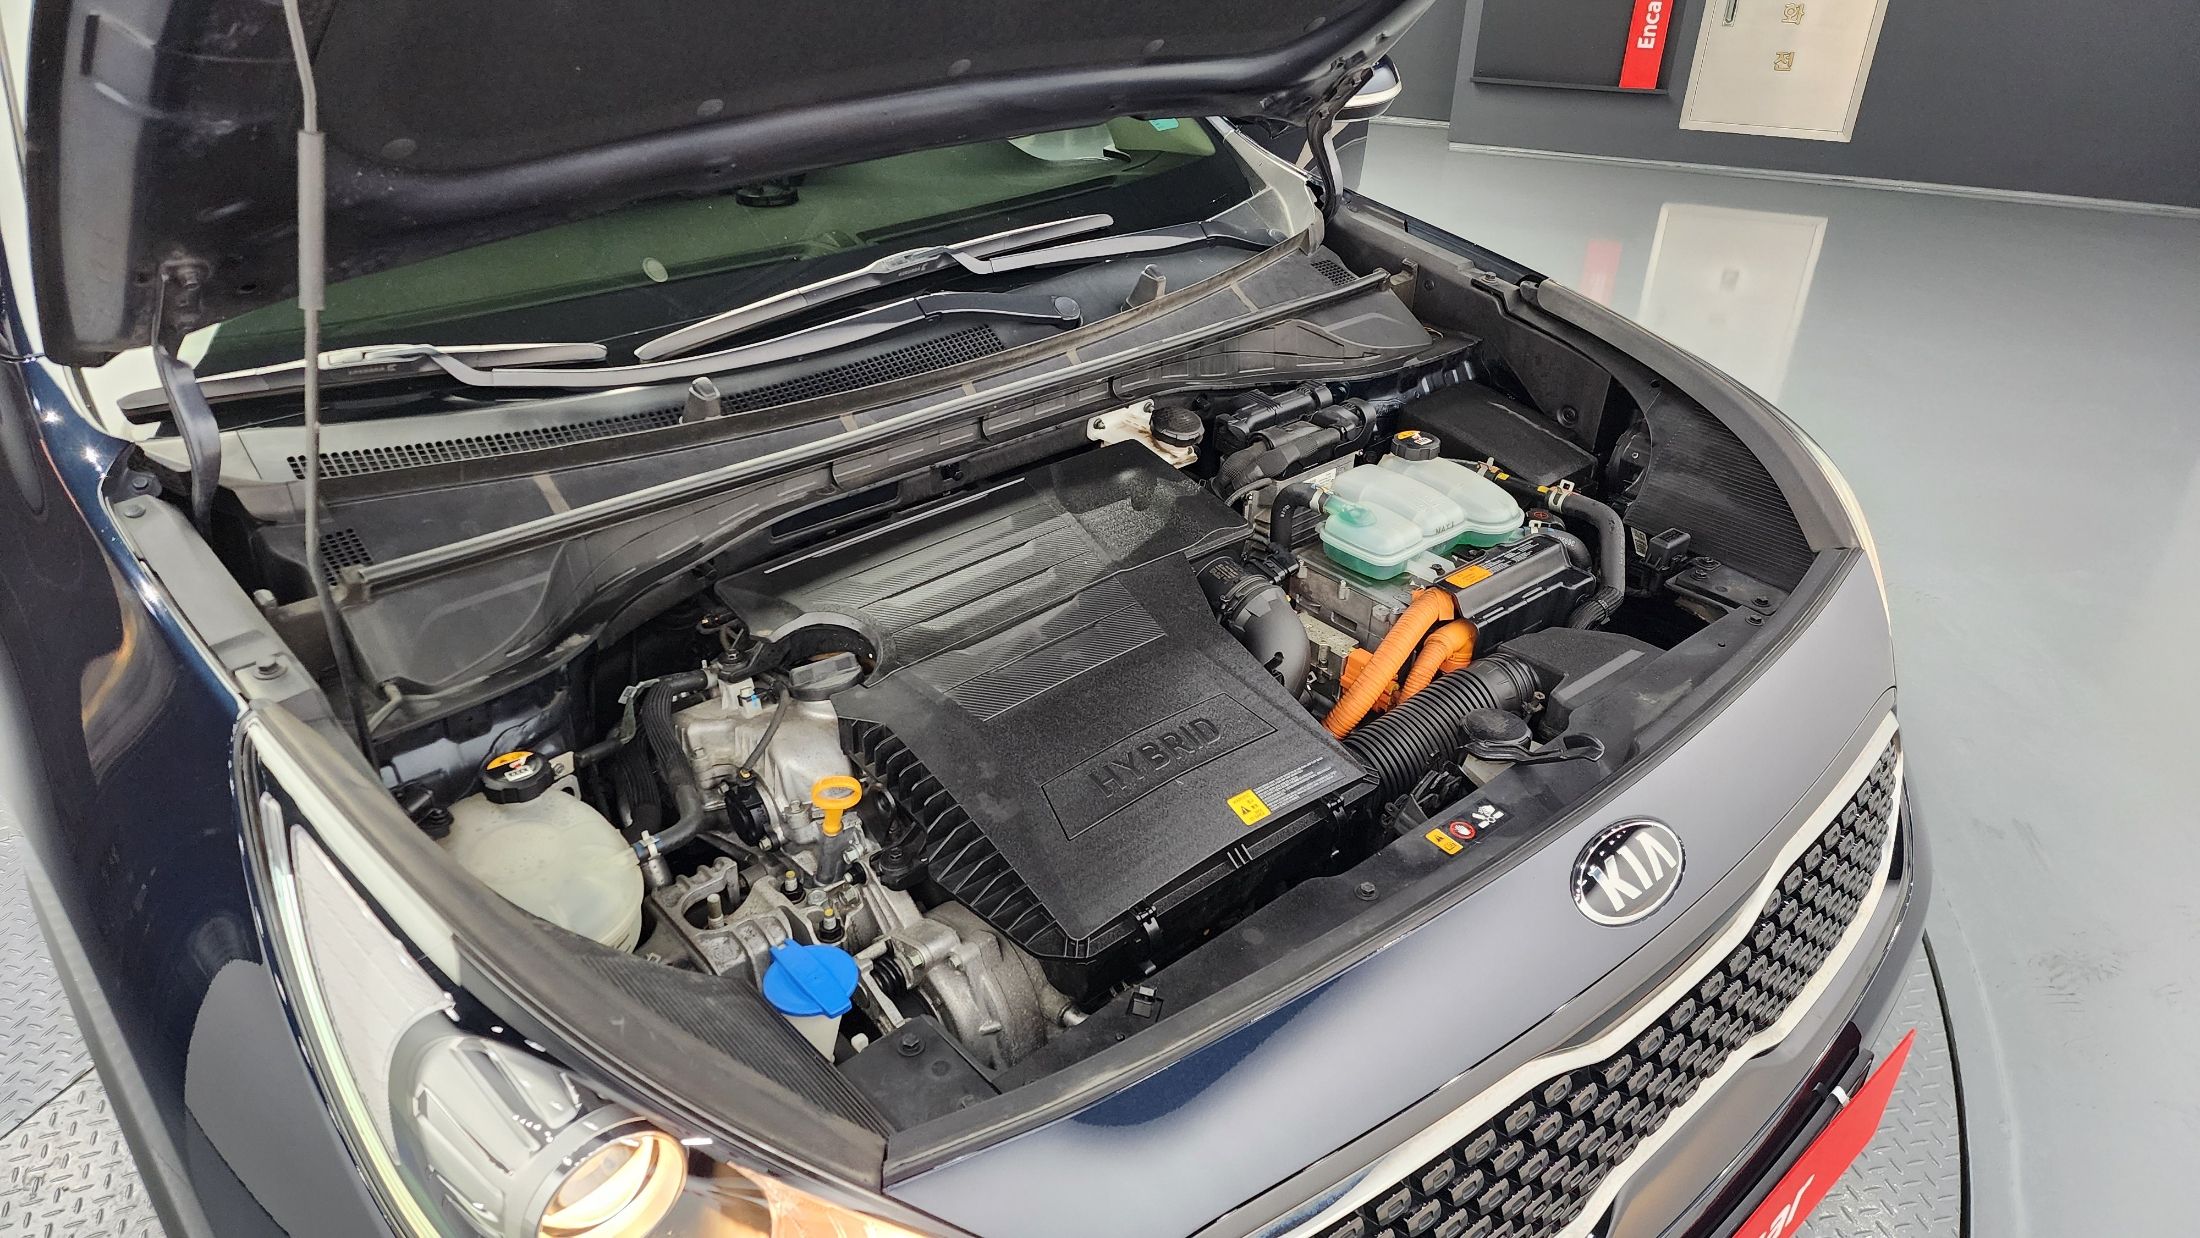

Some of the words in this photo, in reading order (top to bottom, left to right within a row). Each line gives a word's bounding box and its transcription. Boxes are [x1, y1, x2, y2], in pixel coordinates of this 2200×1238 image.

[1637, 1, 1662, 49] Enca
[1087, 718, 1222, 798] HYBRID
[1587, 831, 1677, 912] KIA
